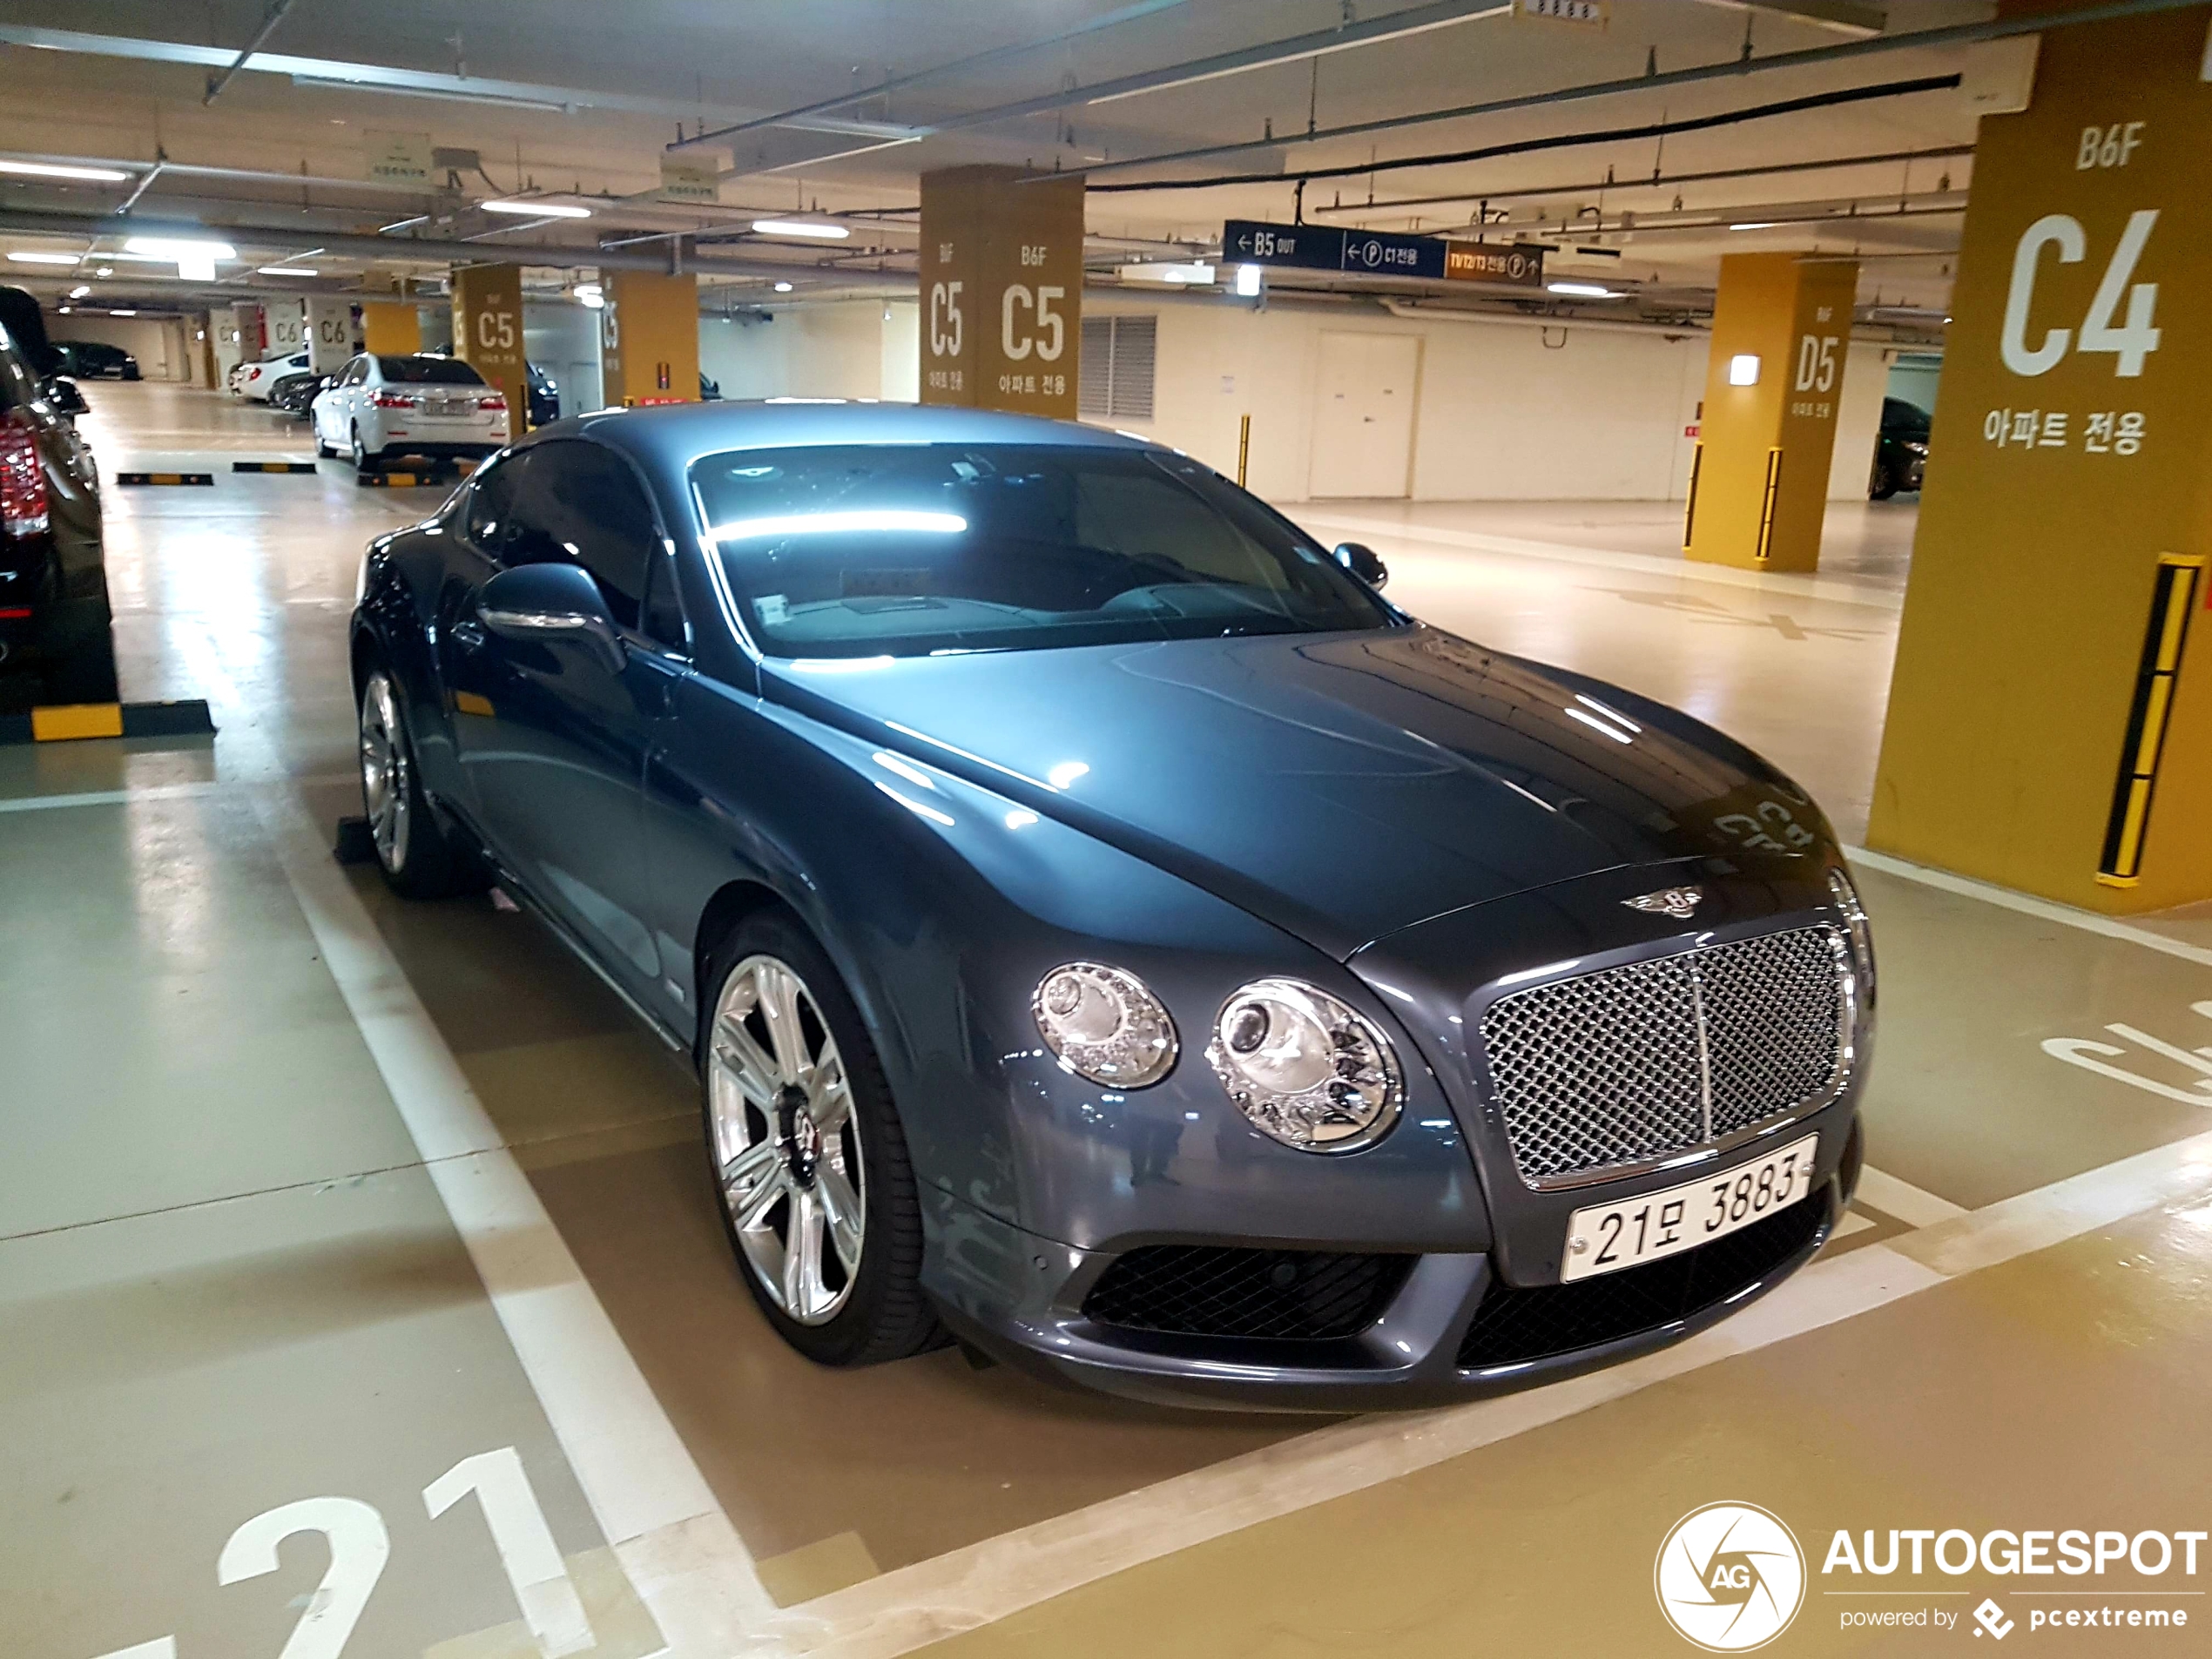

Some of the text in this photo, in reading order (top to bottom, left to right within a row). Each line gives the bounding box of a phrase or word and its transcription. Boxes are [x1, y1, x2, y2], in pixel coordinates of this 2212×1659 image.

[2076, 122, 2146, 171] B6F
[1021, 246, 1047, 266] B6F
[1255, 232, 1297, 256] B5 OUT
[2000, 209, 2161, 376] C4
[275, 323, 298, 342] C6
[320, 320, 346, 343] C6
[480, 312, 514, 347] C5
[931, 281, 962, 357] C5
[1002, 284, 1064, 361] C5
[999, 374, 1065, 395] 아파트 전용
[1795, 334, 1838, 392] D5
[1984, 408, 2146, 455] 아파트 전용
[1593, 1152, 1800, 1265] 21모 3883
[87, 1446, 597, 1659] 21
